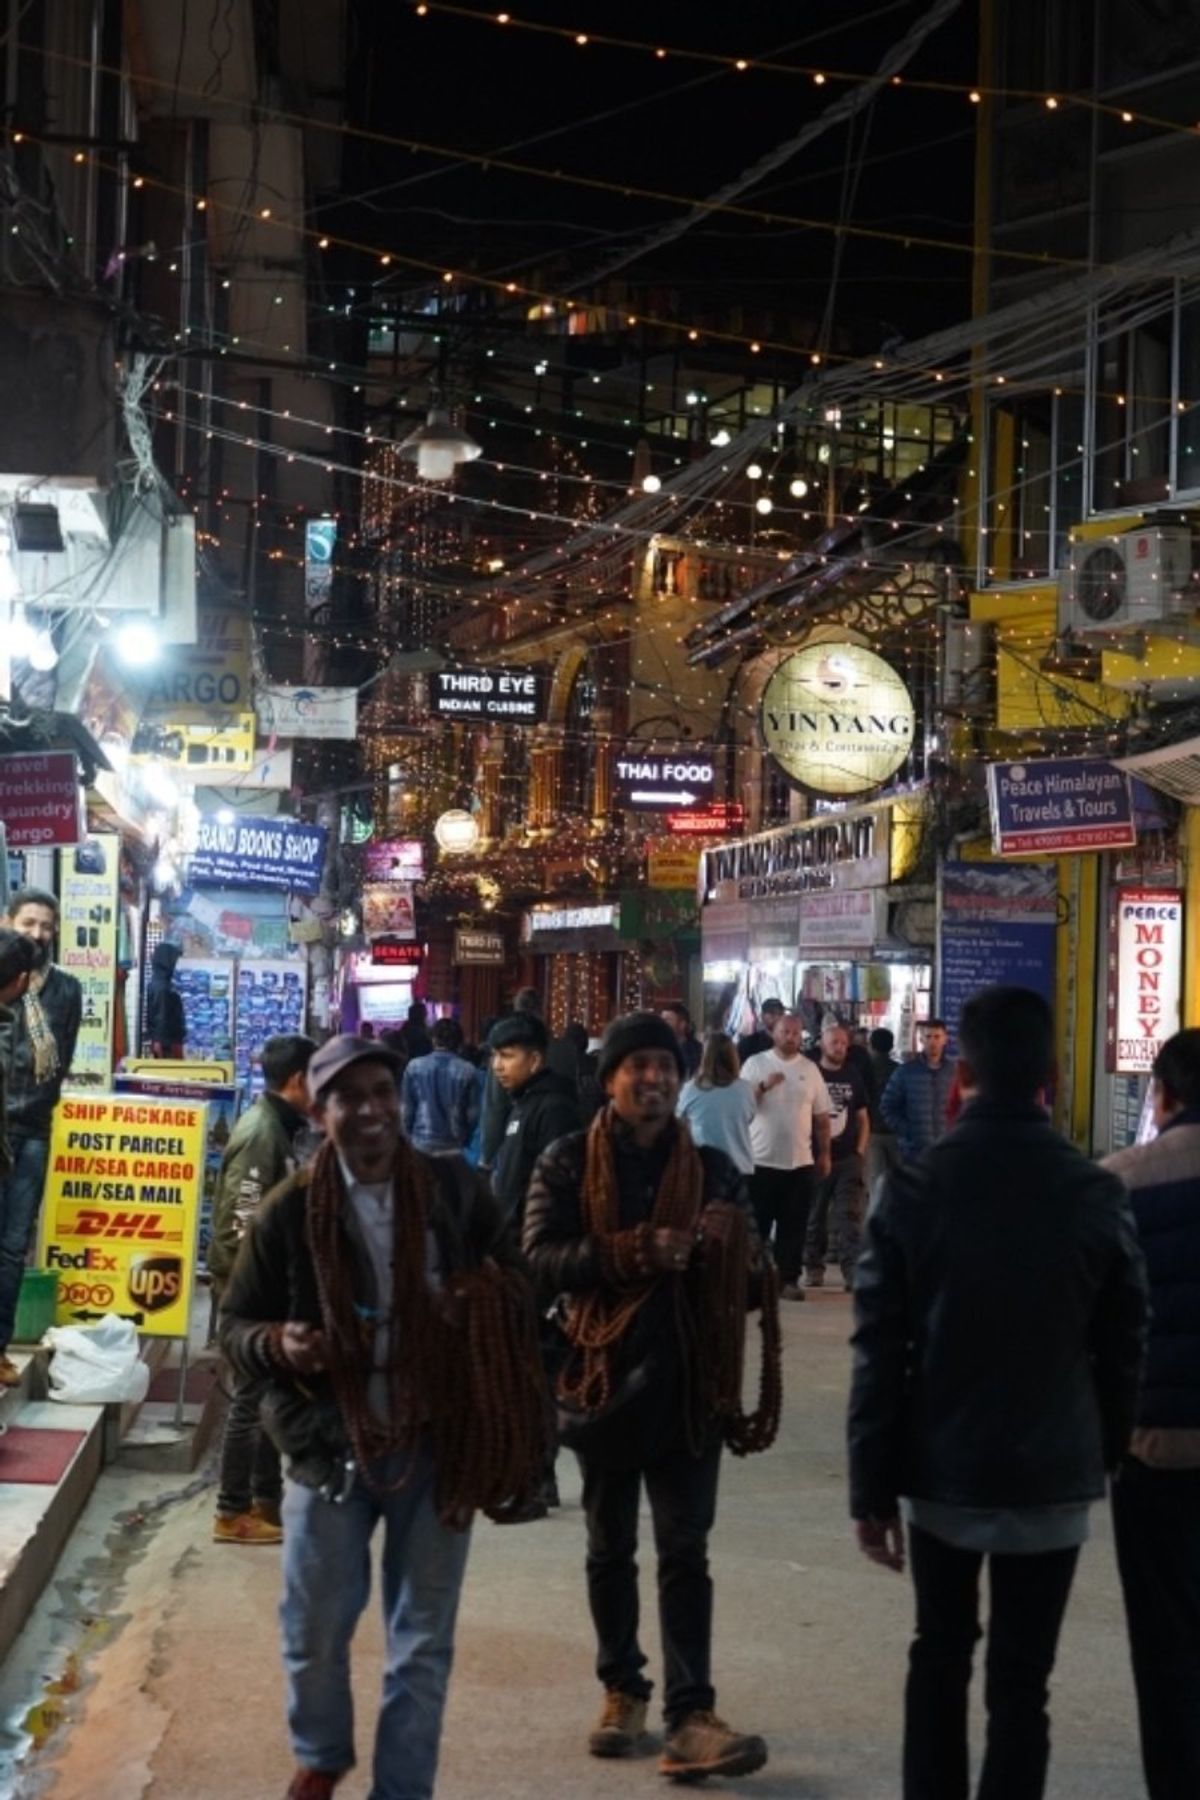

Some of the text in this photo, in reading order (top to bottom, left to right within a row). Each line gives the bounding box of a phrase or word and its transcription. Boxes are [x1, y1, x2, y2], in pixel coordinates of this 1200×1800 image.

[148, 672, 240, 704] ARGO
[440, 674, 535, 694] THIRD EYE
[439, 698, 536, 714] INDIAN CUISINE
[767, 712, 909, 735] YIN YANG
[3, 757, 48, 774] ravel
[617, 763, 713, 782] THAI FOOD
[1000, 770, 1120, 797] Peace Himalayan
[1009, 797, 1117, 822] Travels & Tours
[238, 828, 282, 860] BOOKS
[283, 834, 319, 863] SHOP
[1123, 905, 1177, 921] PEACE
[1135, 924, 1164, 1038] MONEY
[63, 1102, 197, 1127] SHIP PACKAGE
[67, 1131, 185, 1156] POST PARCEL
[55, 1155, 194, 1180] AIR/SEA CARGO
[62, 1180, 183, 1204] AIR/SEA MAIL
[74, 1209, 165, 1240] DHL
[46, 1245, 118, 1271] FedEx
[131, 1269, 180, 1305] ups
